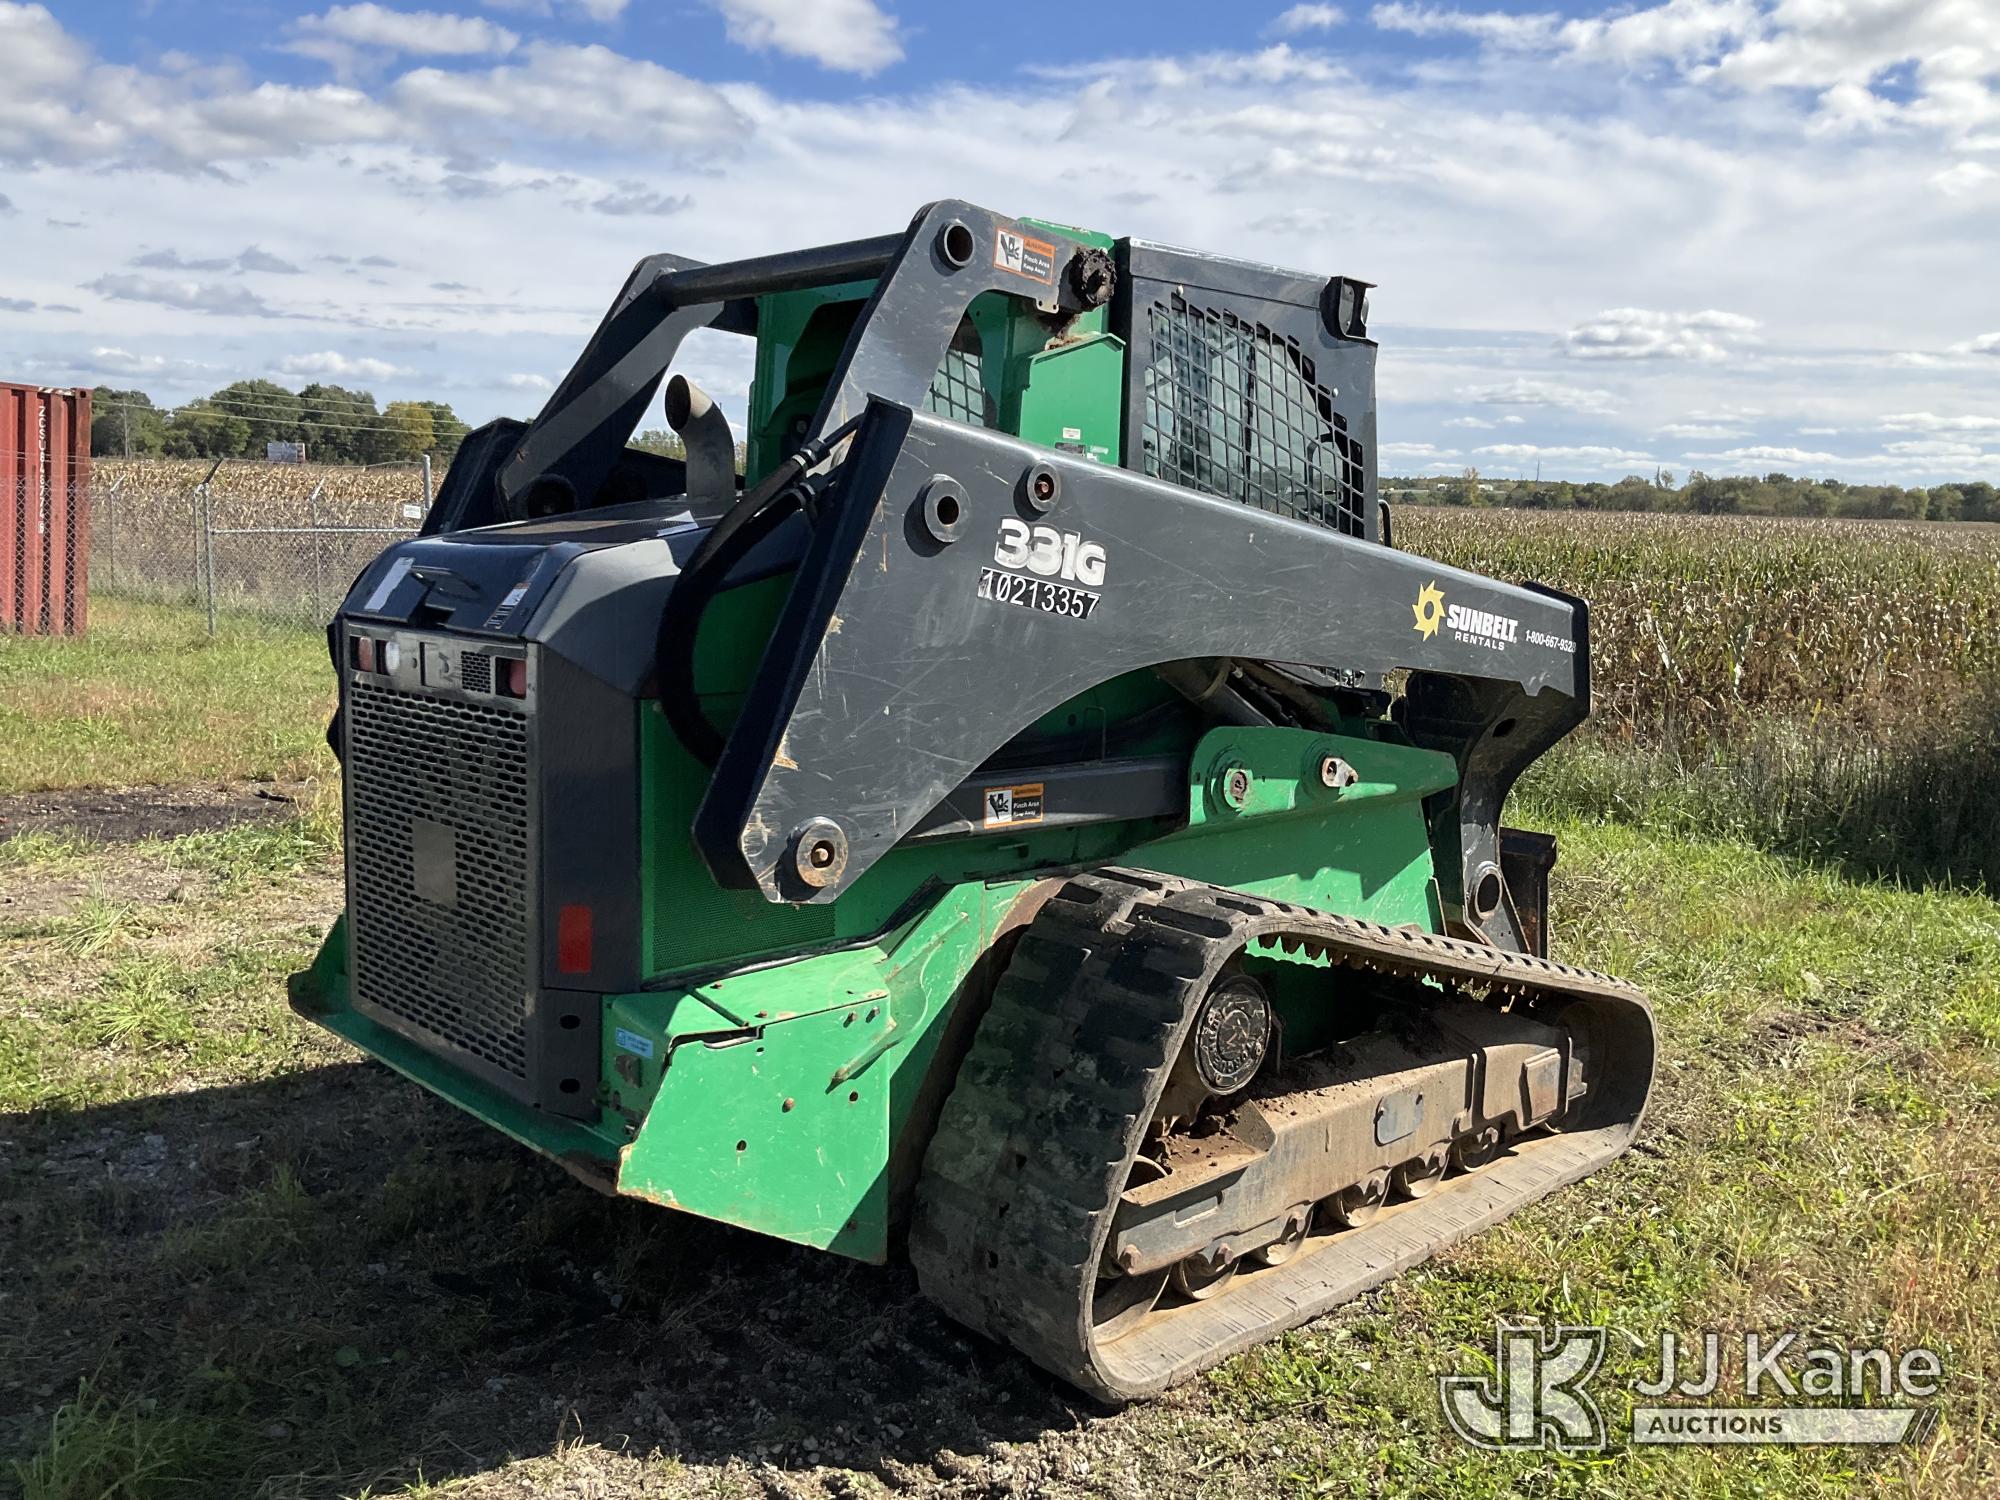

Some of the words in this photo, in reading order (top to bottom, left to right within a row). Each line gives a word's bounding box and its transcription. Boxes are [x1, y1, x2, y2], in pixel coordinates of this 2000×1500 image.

[1023, 254, 1039, 266] Pinch
[1038, 259, 1050, 269] Area
[1034, 267, 1046, 276] Away
[994, 518, 1106, 587] 331G
[981, 570, 1100, 618] 10213357
[1447, 604, 1518, 642] SUNBELT
[1454, 631, 1505, 651] RENTALS
